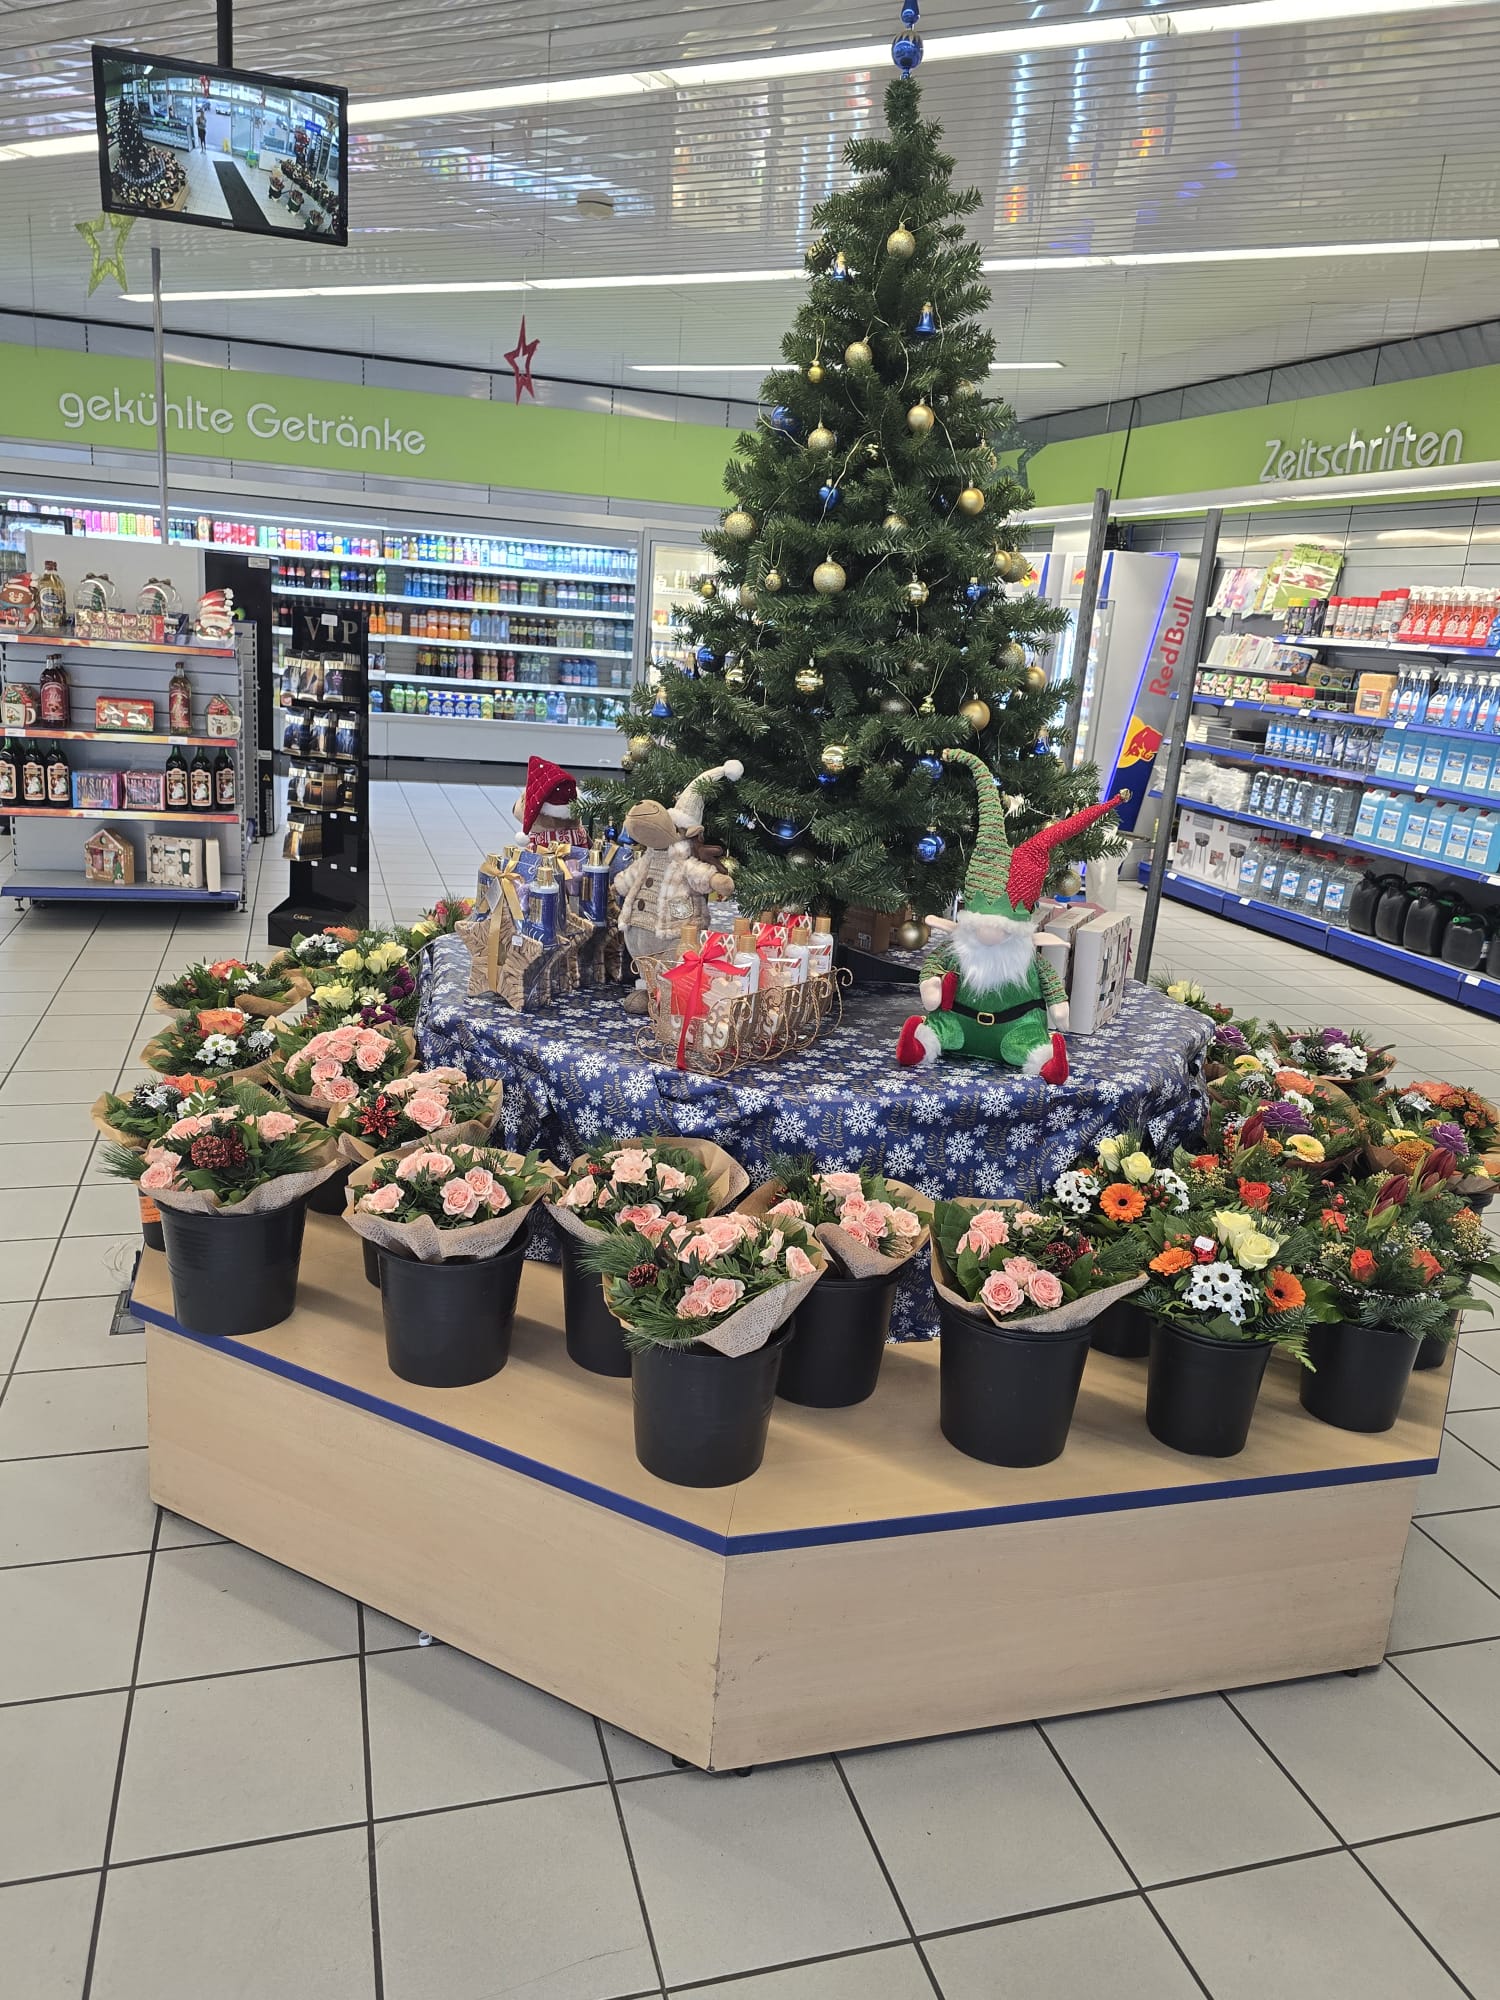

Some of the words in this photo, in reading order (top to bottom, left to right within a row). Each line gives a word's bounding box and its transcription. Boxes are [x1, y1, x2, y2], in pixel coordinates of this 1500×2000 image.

[58, 387, 235, 434] gekühlte
[247, 403, 426, 455] Getränke
[1259, 421, 1463, 483] Zeitschriften
[304, 615, 358, 644] VIP
[1148, 646, 1180, 696] Red
[1164, 596, 1194, 646] Bull
[819, 1110, 836, 1150] Merry
[831, 1106, 845, 1149] Christmas
